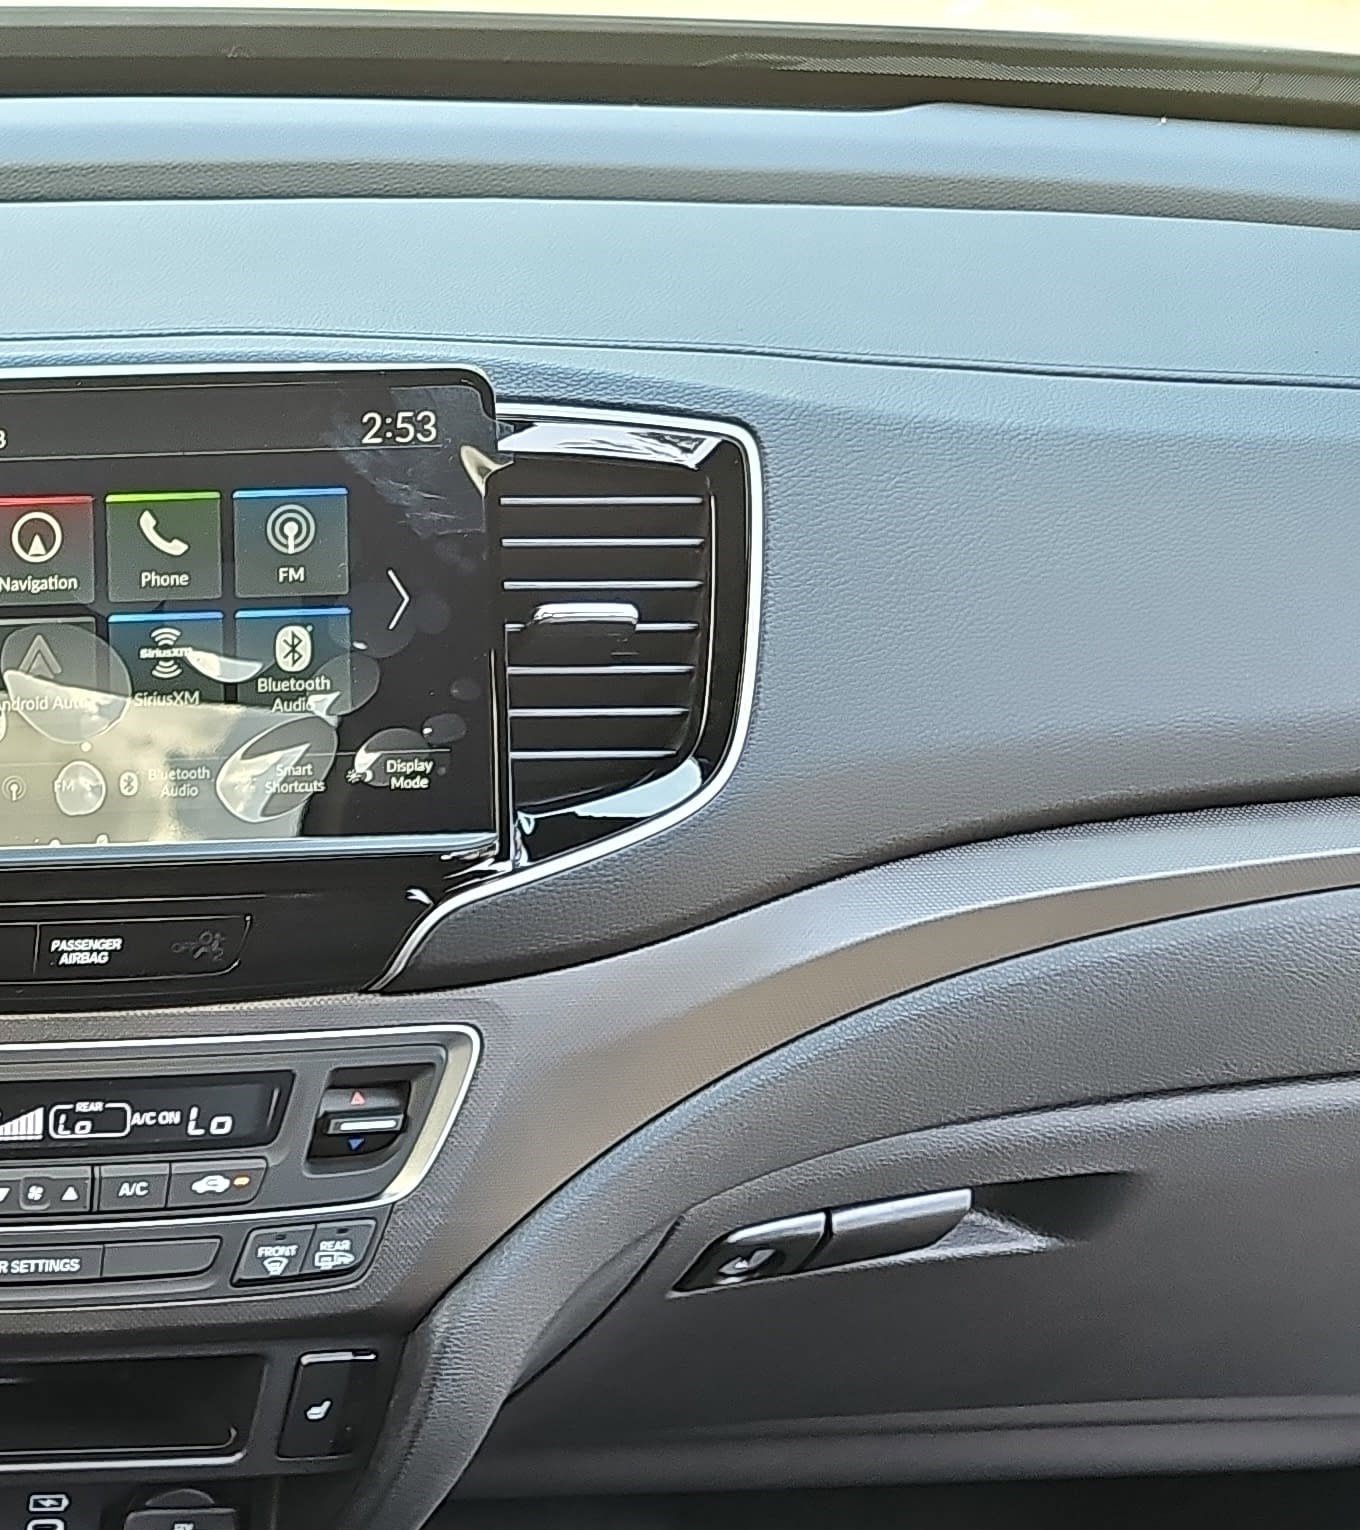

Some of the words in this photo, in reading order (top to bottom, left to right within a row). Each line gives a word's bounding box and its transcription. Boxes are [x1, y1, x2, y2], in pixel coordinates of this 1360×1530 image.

[361, 411, 438, 445] 2:53
[140, 570, 190, 588] Phone
[279, 567, 305, 583] FM
[257, 675, 331, 692] Bluetooth
[134, 690, 201, 707] SiriusXM
[271, 697, 316, 713] Audio
[148, 766, 211, 782] Bluetooth
[276, 763, 313, 777] Smart
[387, 759, 433, 775] Display
[54, 779, 76, 793] FM
[265, 779, 326, 794] Shortcuts
[390, 775, 429, 790] Mode
[160, 784, 199, 798] Audio
[51, 936, 122, 952] PASSENGER
[58, 950, 110, 966] AIRBAG
[75, 1102, 104, 1113] REAR
[57, 1113, 93, 1135] Lo
[131, 1112, 157, 1126] A/C
[157, 1111, 181, 1125] ON
[187, 1106, 233, 1136] Lo
[118, 1180, 149, 1198] A/C
[257, 1243, 298, 1258] FRONT
[319, 1240, 352, 1253] REAR
[10, 1256, 81, 1275] SETTINGS
